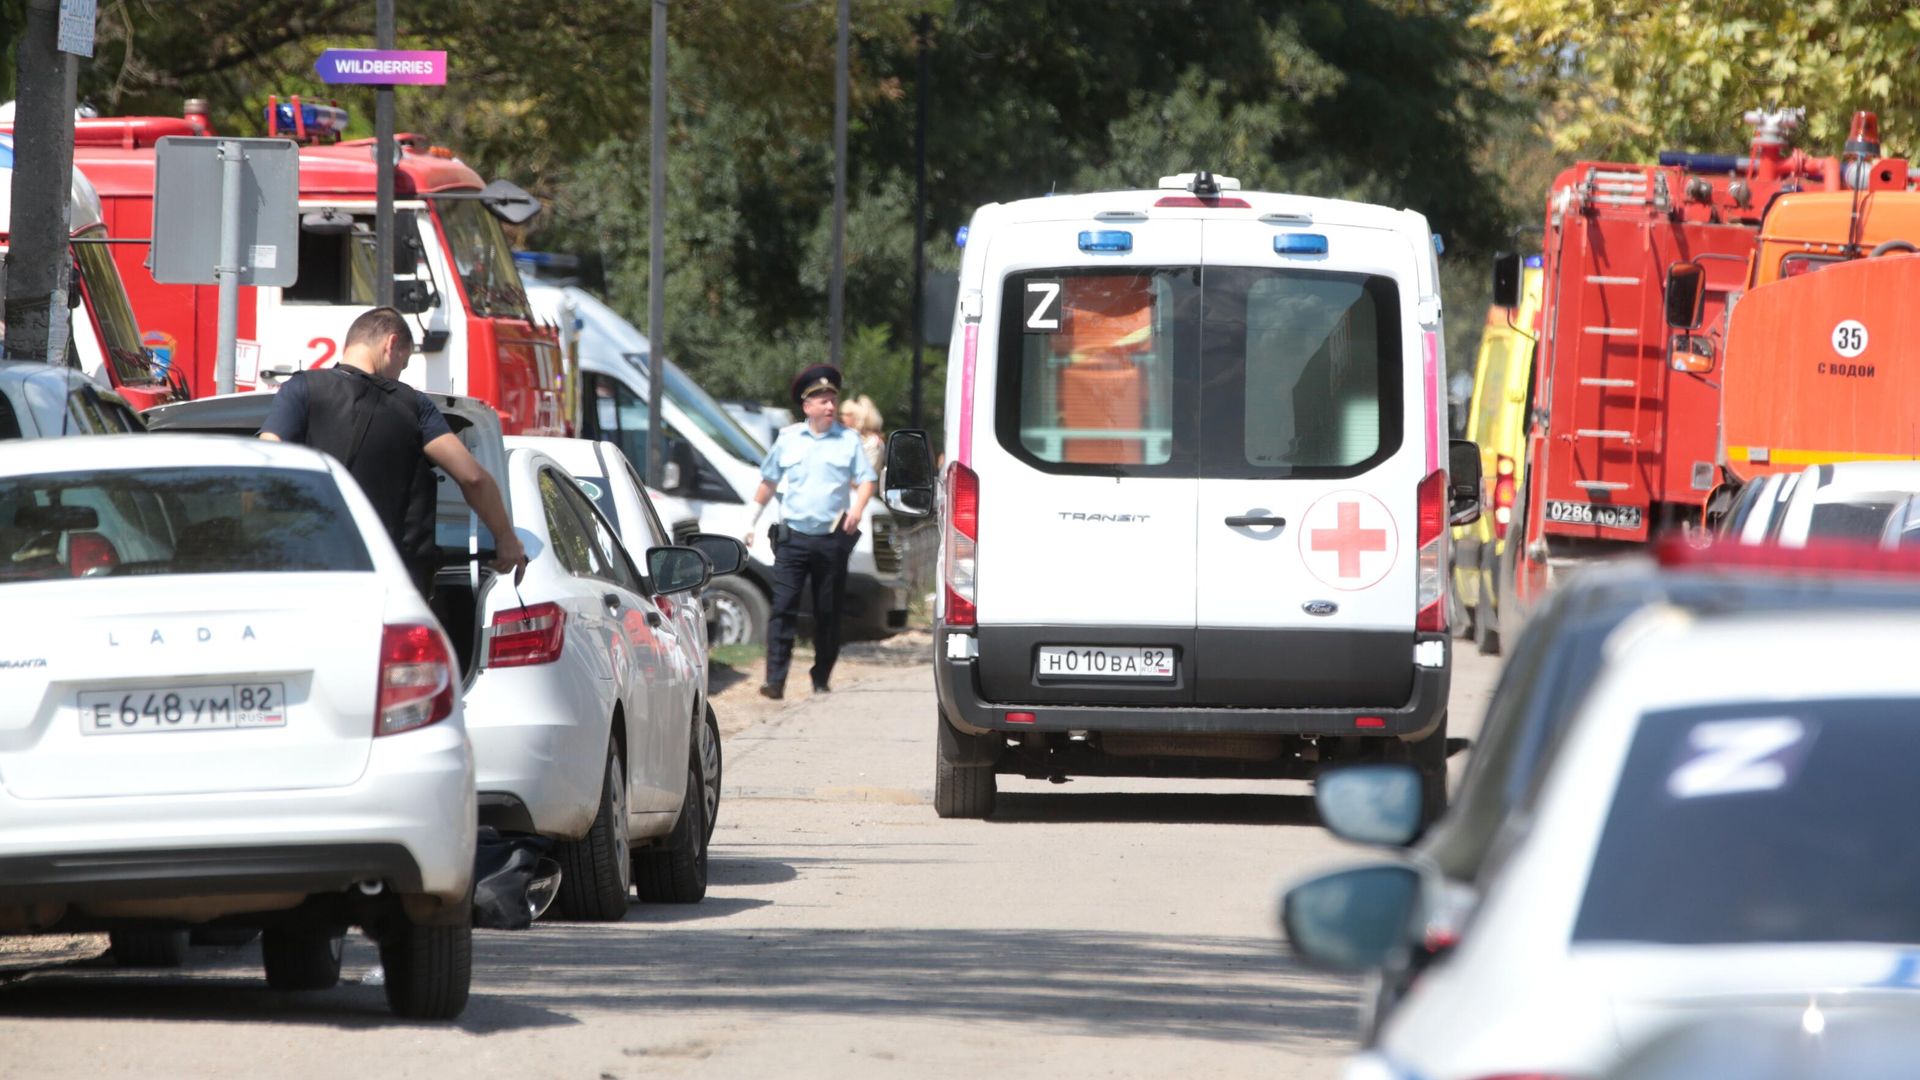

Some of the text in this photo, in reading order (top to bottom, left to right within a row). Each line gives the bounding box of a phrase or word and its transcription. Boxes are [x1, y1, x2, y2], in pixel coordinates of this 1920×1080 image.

[335, 59, 433, 75] WILDBERRIES
[1026, 283, 1060, 328] Z
[1838, 327, 1861, 350] 35
[1817, 361, 1875, 378] С ВОДОЙ
[1058, 512, 1150, 523] TRANSIT
[108, 625, 256, 647] LADA
[1143, 651, 1165, 667] 82
[239, 687, 272, 711] 82
[238, 712, 265, 722] RUS
[1670, 715, 1805, 800] Z
